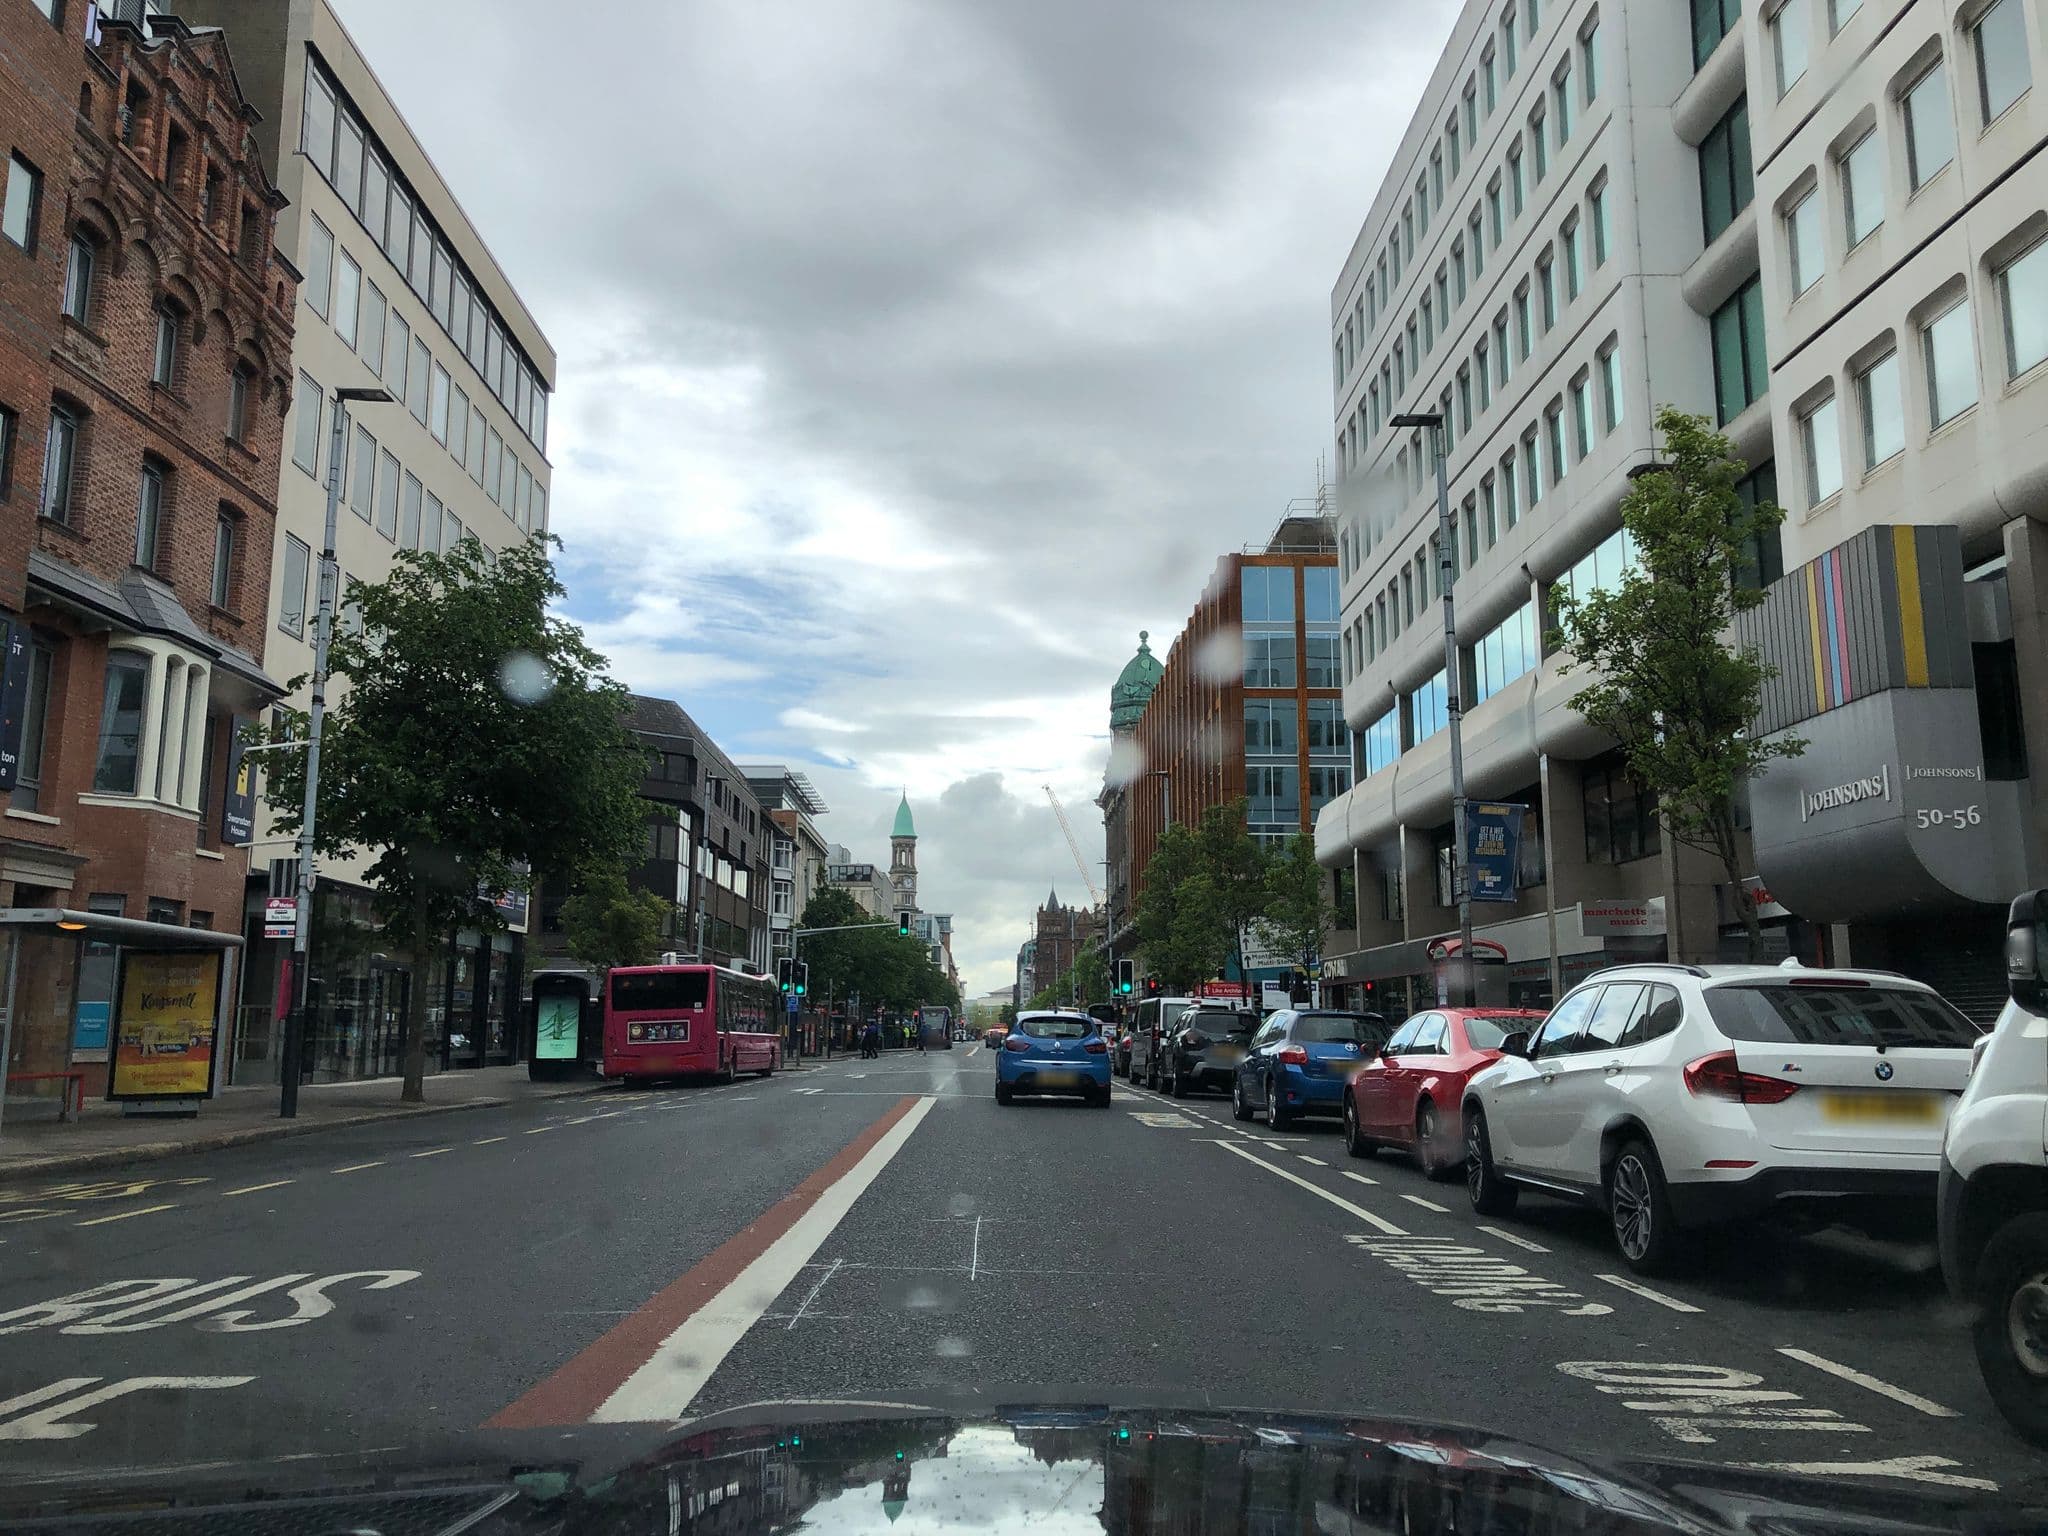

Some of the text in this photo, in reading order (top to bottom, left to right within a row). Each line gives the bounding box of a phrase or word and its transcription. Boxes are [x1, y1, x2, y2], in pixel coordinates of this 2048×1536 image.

[1912, 766, 1976, 779] JOHNSONS
[1807, 775, 1883, 816] JOHNSONS
[1916, 804, 1981, 830] 50-56
[1583, 906, 1648, 917] matchetts
[1609, 918, 1648, 926] music
